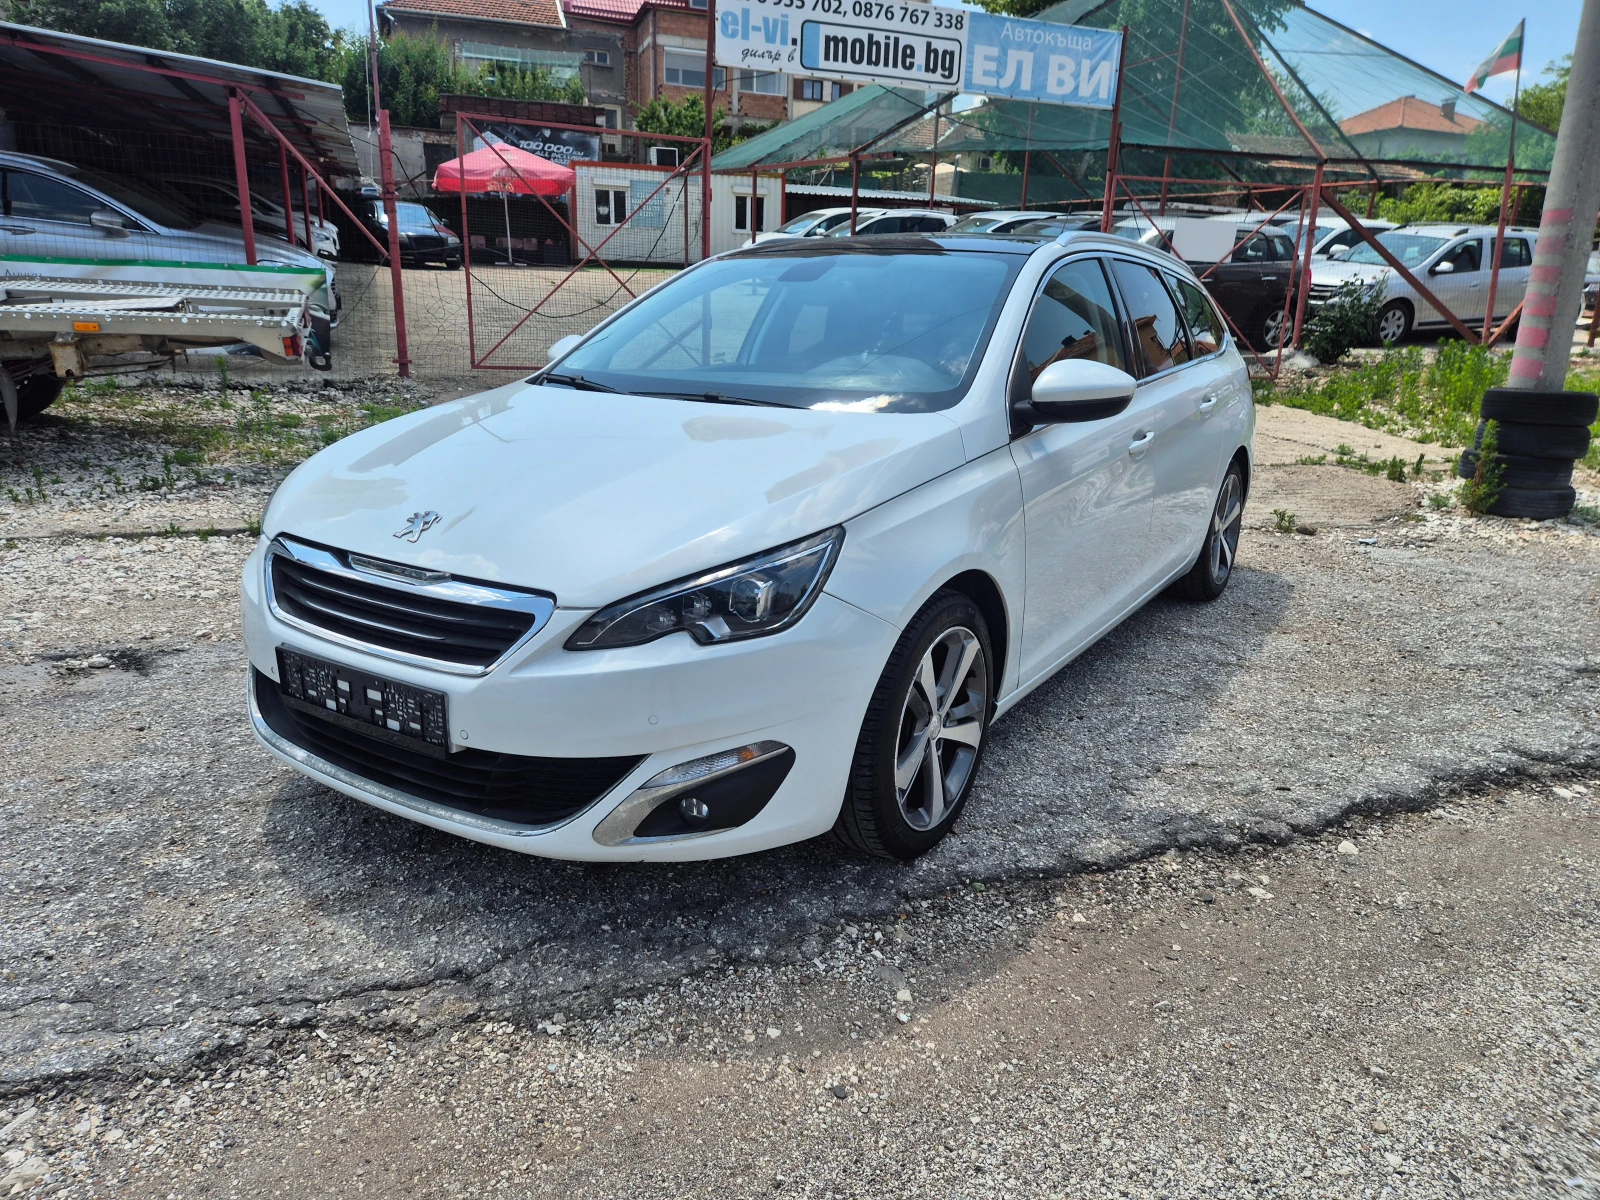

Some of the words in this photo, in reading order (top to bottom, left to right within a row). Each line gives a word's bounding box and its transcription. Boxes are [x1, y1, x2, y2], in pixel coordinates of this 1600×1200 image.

[852, 1, 894, 21] 0876
[899, 7, 930, 26] 767
[934, 12, 964, 30] 338
[1001, 22, 1093, 51] Автокъща
[824, 33, 955, 80] mobile.bg
[971, 44, 1034, 92] ЕЛ
[1046, 54, 1111, 99] ВИ
[544, 143, 573, 155] 000
